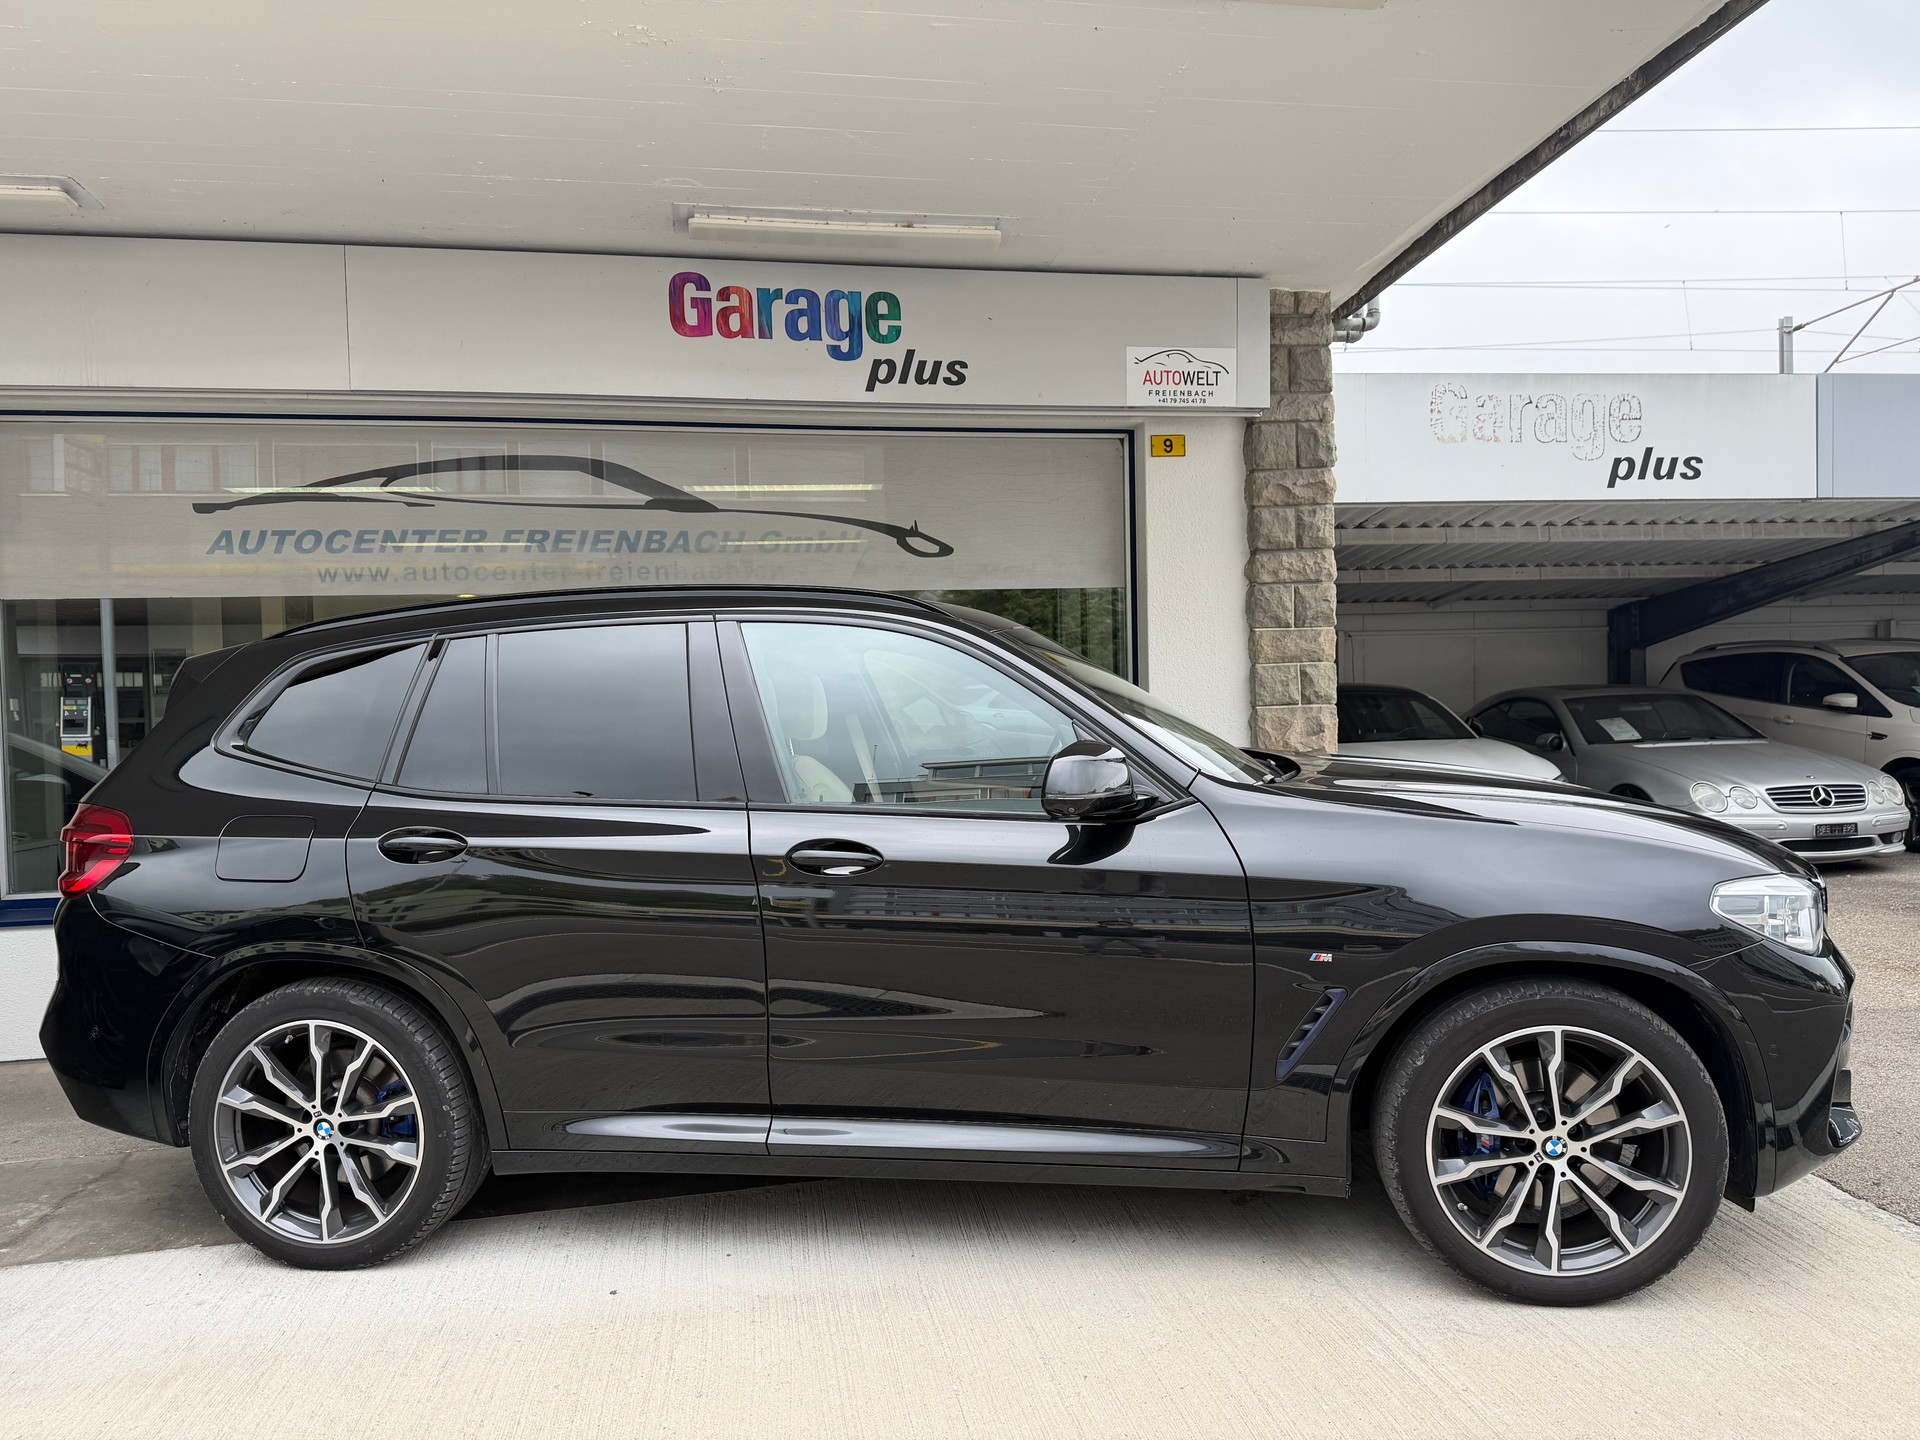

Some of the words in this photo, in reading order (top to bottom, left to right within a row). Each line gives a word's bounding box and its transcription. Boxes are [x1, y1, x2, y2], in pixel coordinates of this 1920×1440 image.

[667, 271, 902, 361] Garage
[865, 348, 968, 392] plus
[1142, 370, 1221, 386] AUTOWELT
[1148, 389, 1214, 397] FREIENBACH
[1178, 397, 1190, 405] 745
[1191, 397, 1198, 405] 41
[1430, 383, 1642, 461] Garage
[1163, 438, 1174, 454] 9
[1606, 447, 1703, 489] plus
[206, 529, 489, 555] AUTOCENTER
[499, 529, 742, 555] FREIENBACH
[758, 529, 863, 555] GmbH
